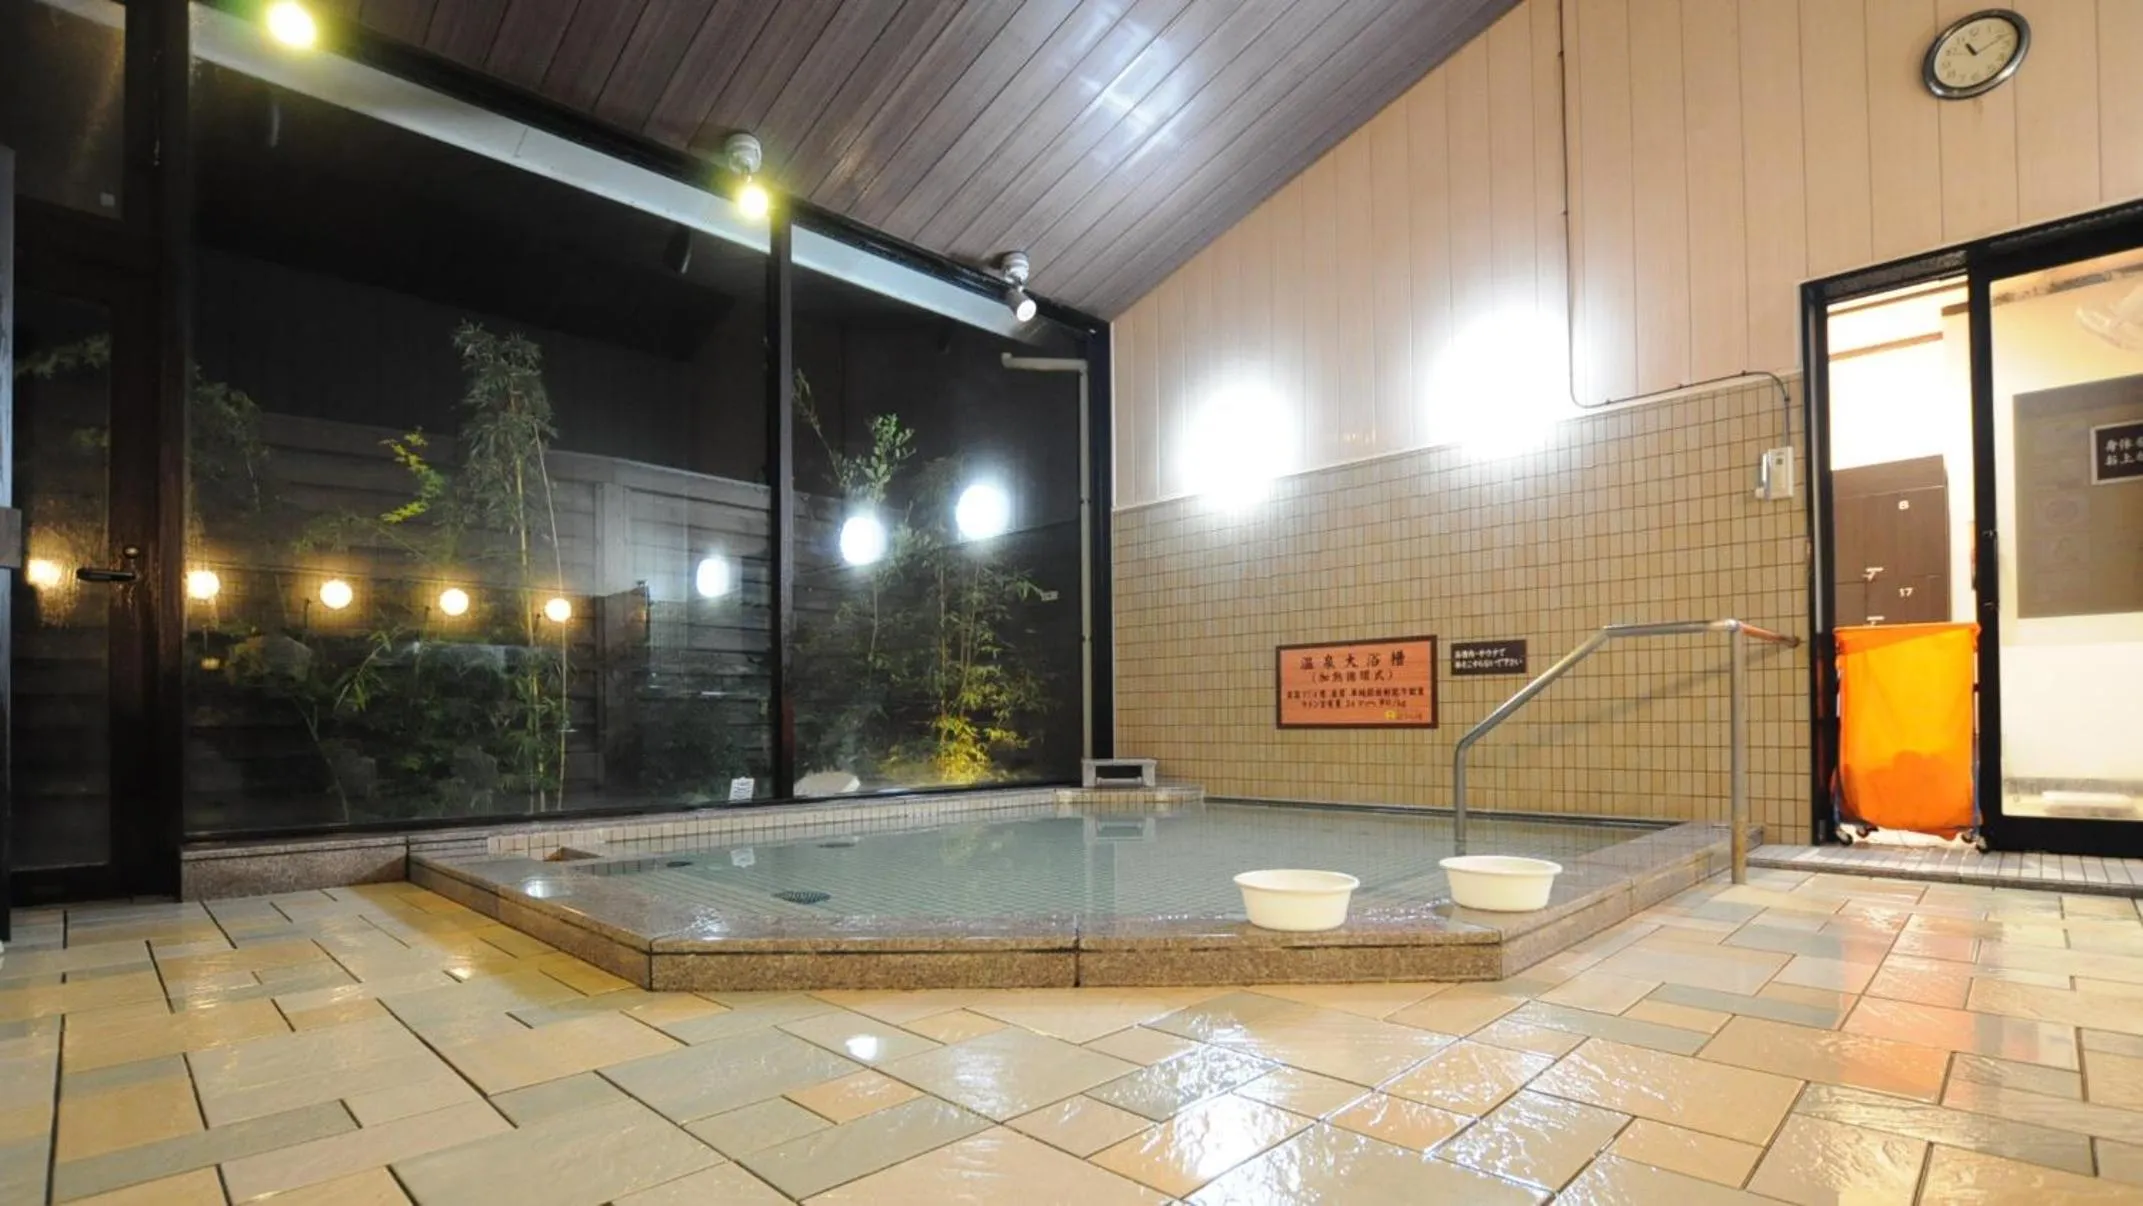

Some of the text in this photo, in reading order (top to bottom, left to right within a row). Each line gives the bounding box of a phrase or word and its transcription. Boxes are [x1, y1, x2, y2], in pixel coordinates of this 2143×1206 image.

[1899, 587, 1913, 597] 17
[1300, 650, 1405, 670] 温泉大浴槽
